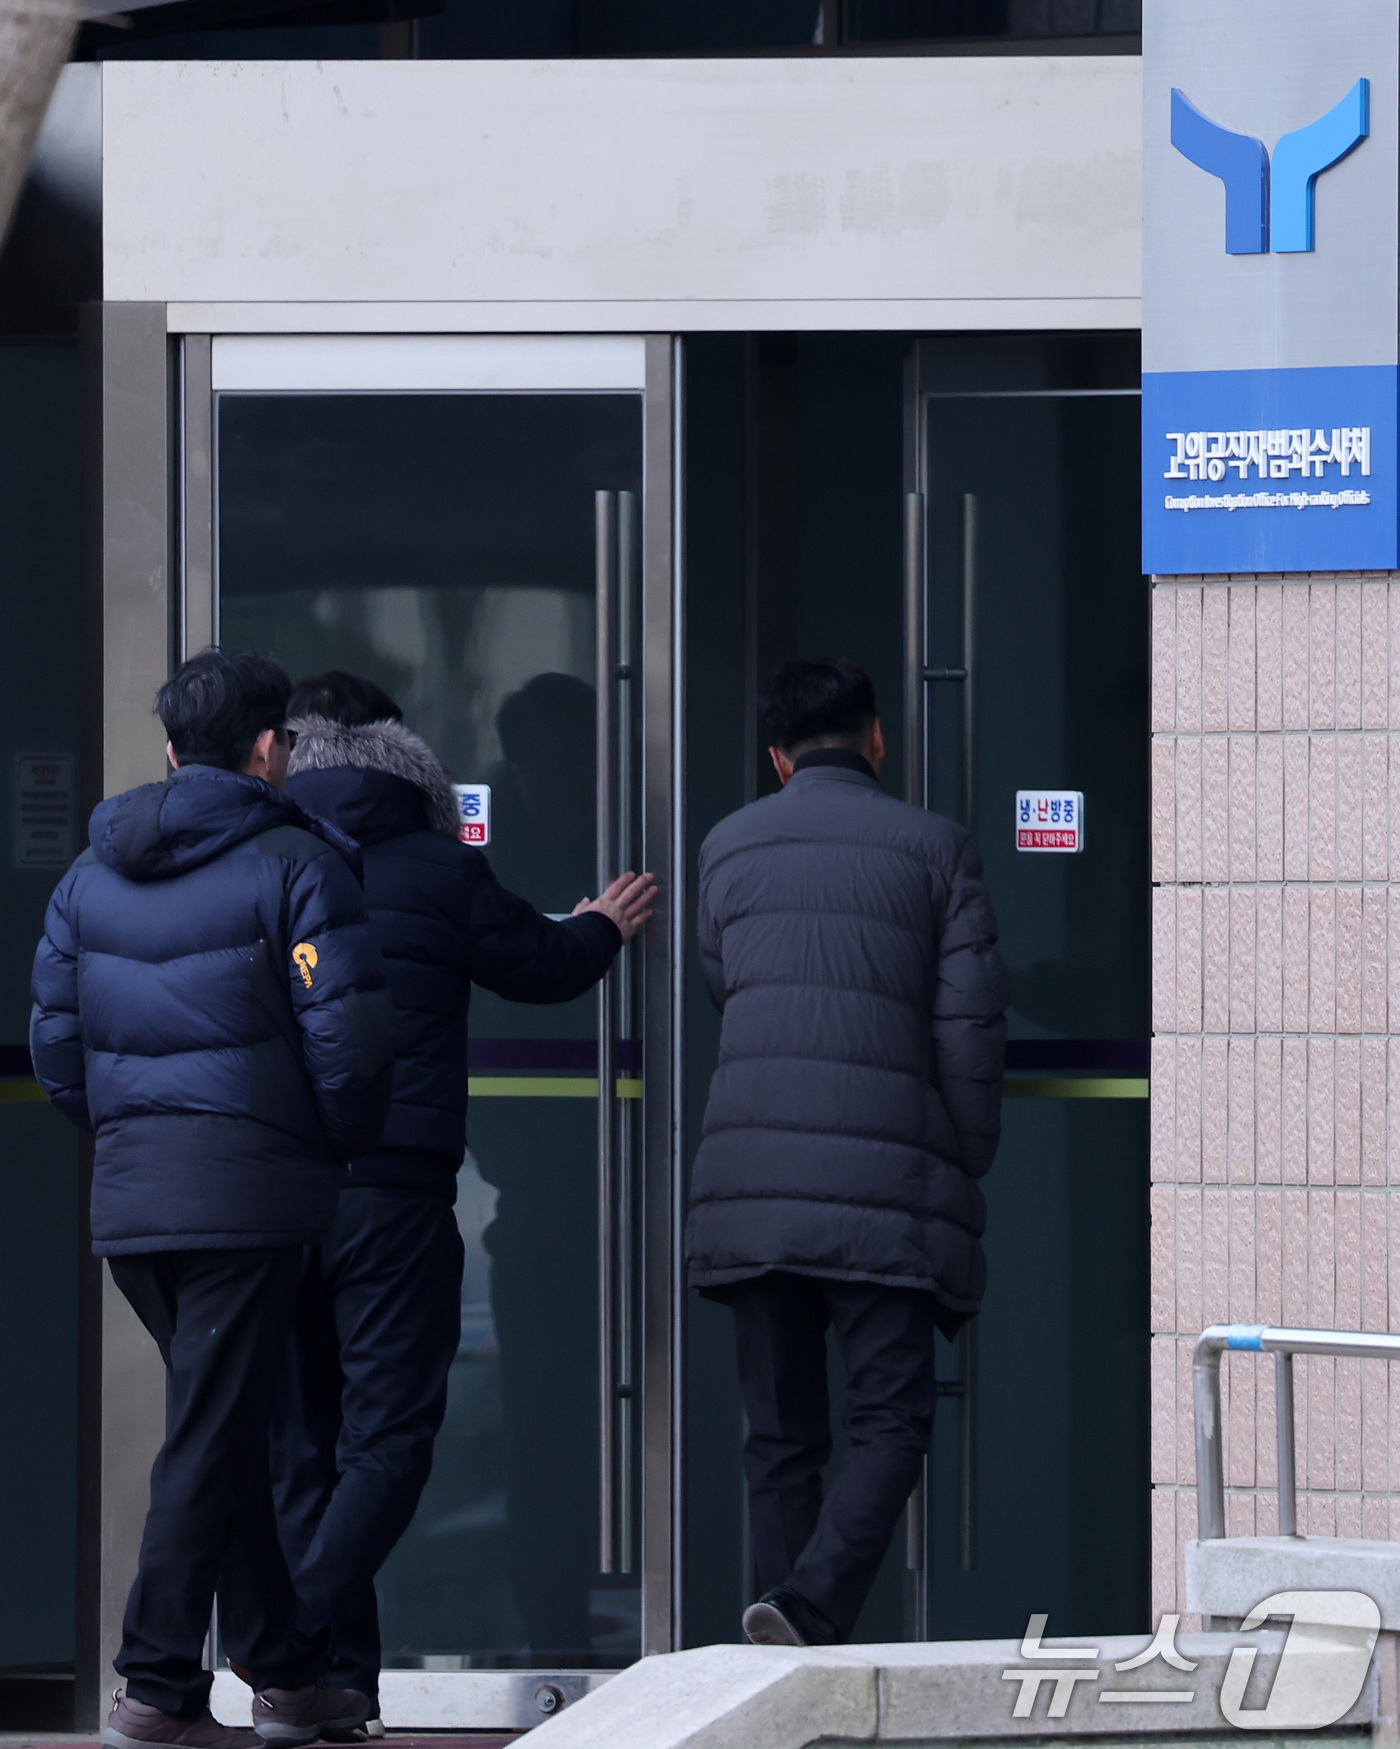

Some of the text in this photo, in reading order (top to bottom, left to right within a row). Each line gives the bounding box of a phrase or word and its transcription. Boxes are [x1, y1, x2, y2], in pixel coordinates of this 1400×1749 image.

[1163, 427, 1371, 481] 고위공직자범죄수사처
[1164, 495, 1205, 512] Corruption
[1205, 494, 1253, 511] Investigation
[1253, 492, 1276, 507] Office
[1338, 489, 1371, 505] Officials
